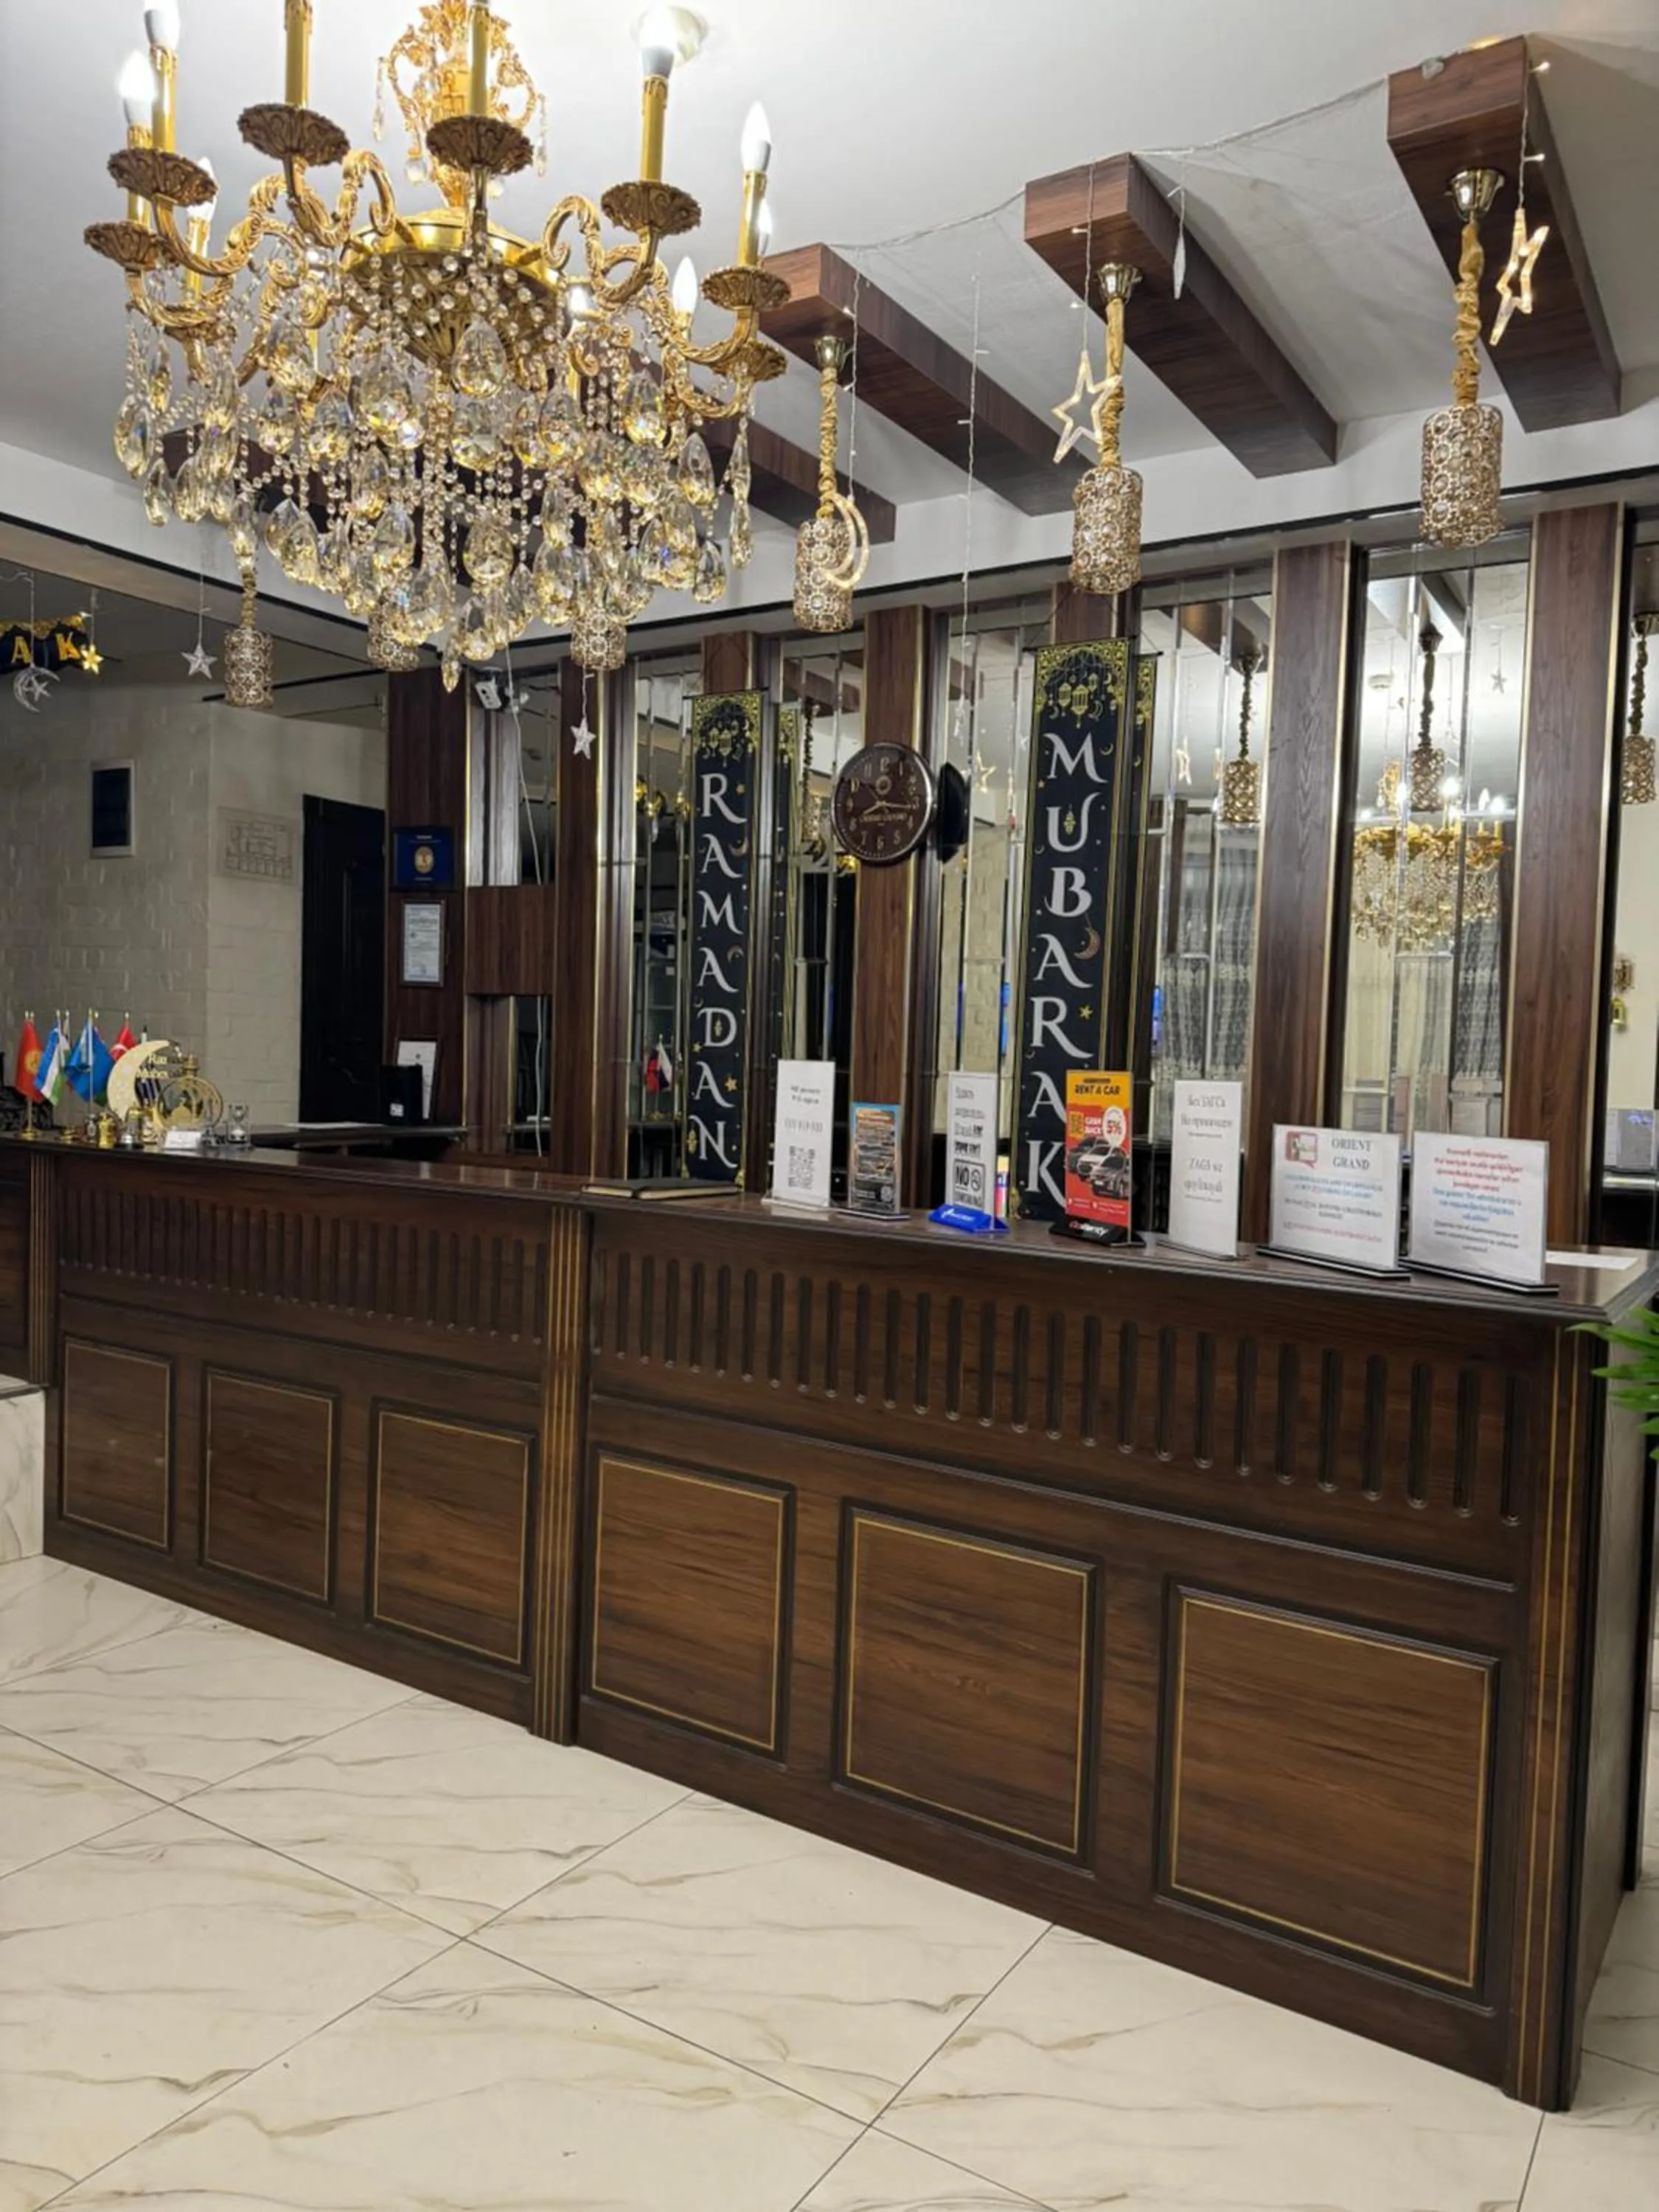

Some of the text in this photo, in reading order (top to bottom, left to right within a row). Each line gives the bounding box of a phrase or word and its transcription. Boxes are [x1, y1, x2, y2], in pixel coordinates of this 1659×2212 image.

[688, 773, 747, 1168] RAMADAN
[1027, 732, 1107, 1208] MUBARAK
[1074, 1085, 1121, 1096] RENT A CAR
[1331, 1138, 1371, 1152] ORIENT
[1332, 1156, 1370, 1170] GRAND
[955, 1165, 970, 1186] NO
